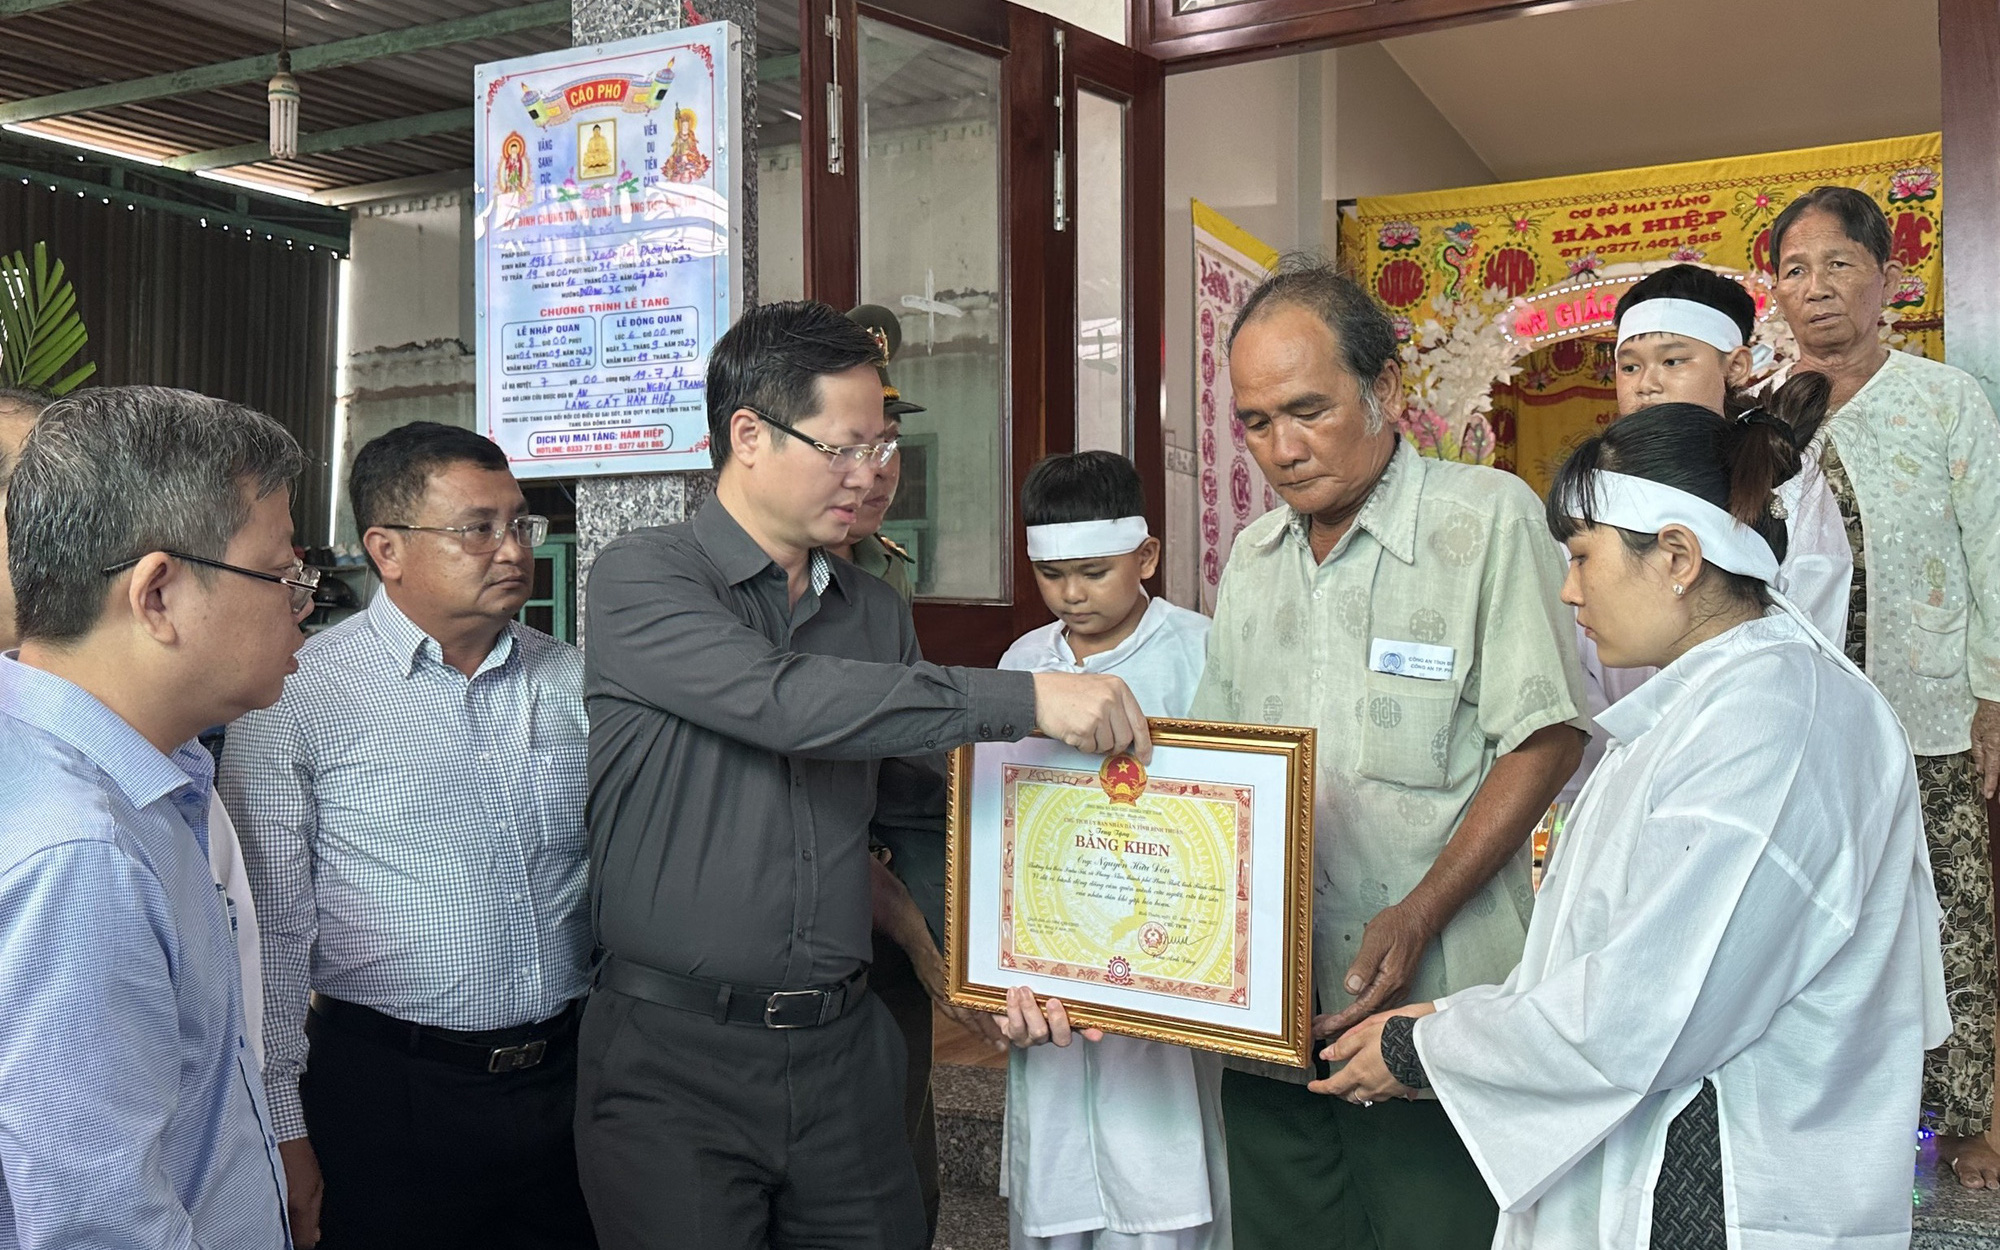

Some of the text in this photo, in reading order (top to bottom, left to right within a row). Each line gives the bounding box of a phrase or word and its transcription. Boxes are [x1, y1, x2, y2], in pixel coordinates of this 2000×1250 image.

[570, 80, 622, 106] CÁO PHÓ
[647, 142, 655, 153] DU
[1569, 194, 1711, 219] CƠ SỞ MAI TÁNG
[1552, 210, 1727, 244] HÀM HIỆP
[540, 297, 670, 317] CHƯƠNG TRÌNH LỄ TANG
[1555, 287, 1617, 328] GIẤC
[517, 324, 580, 337] LỄ NHẬP QUAN
[616, 314, 683, 328] LỄ ĐỘNG QUAN
[536, 427, 664, 446] DỊCH VỤ MAI TÁNG: HÀM HIỆP
[1411, 663, 1426, 671] CÔNG
[1075, 829, 1170, 857] BẰNG KHEN
[1094, 856, 1128, 871] Nguyễn
